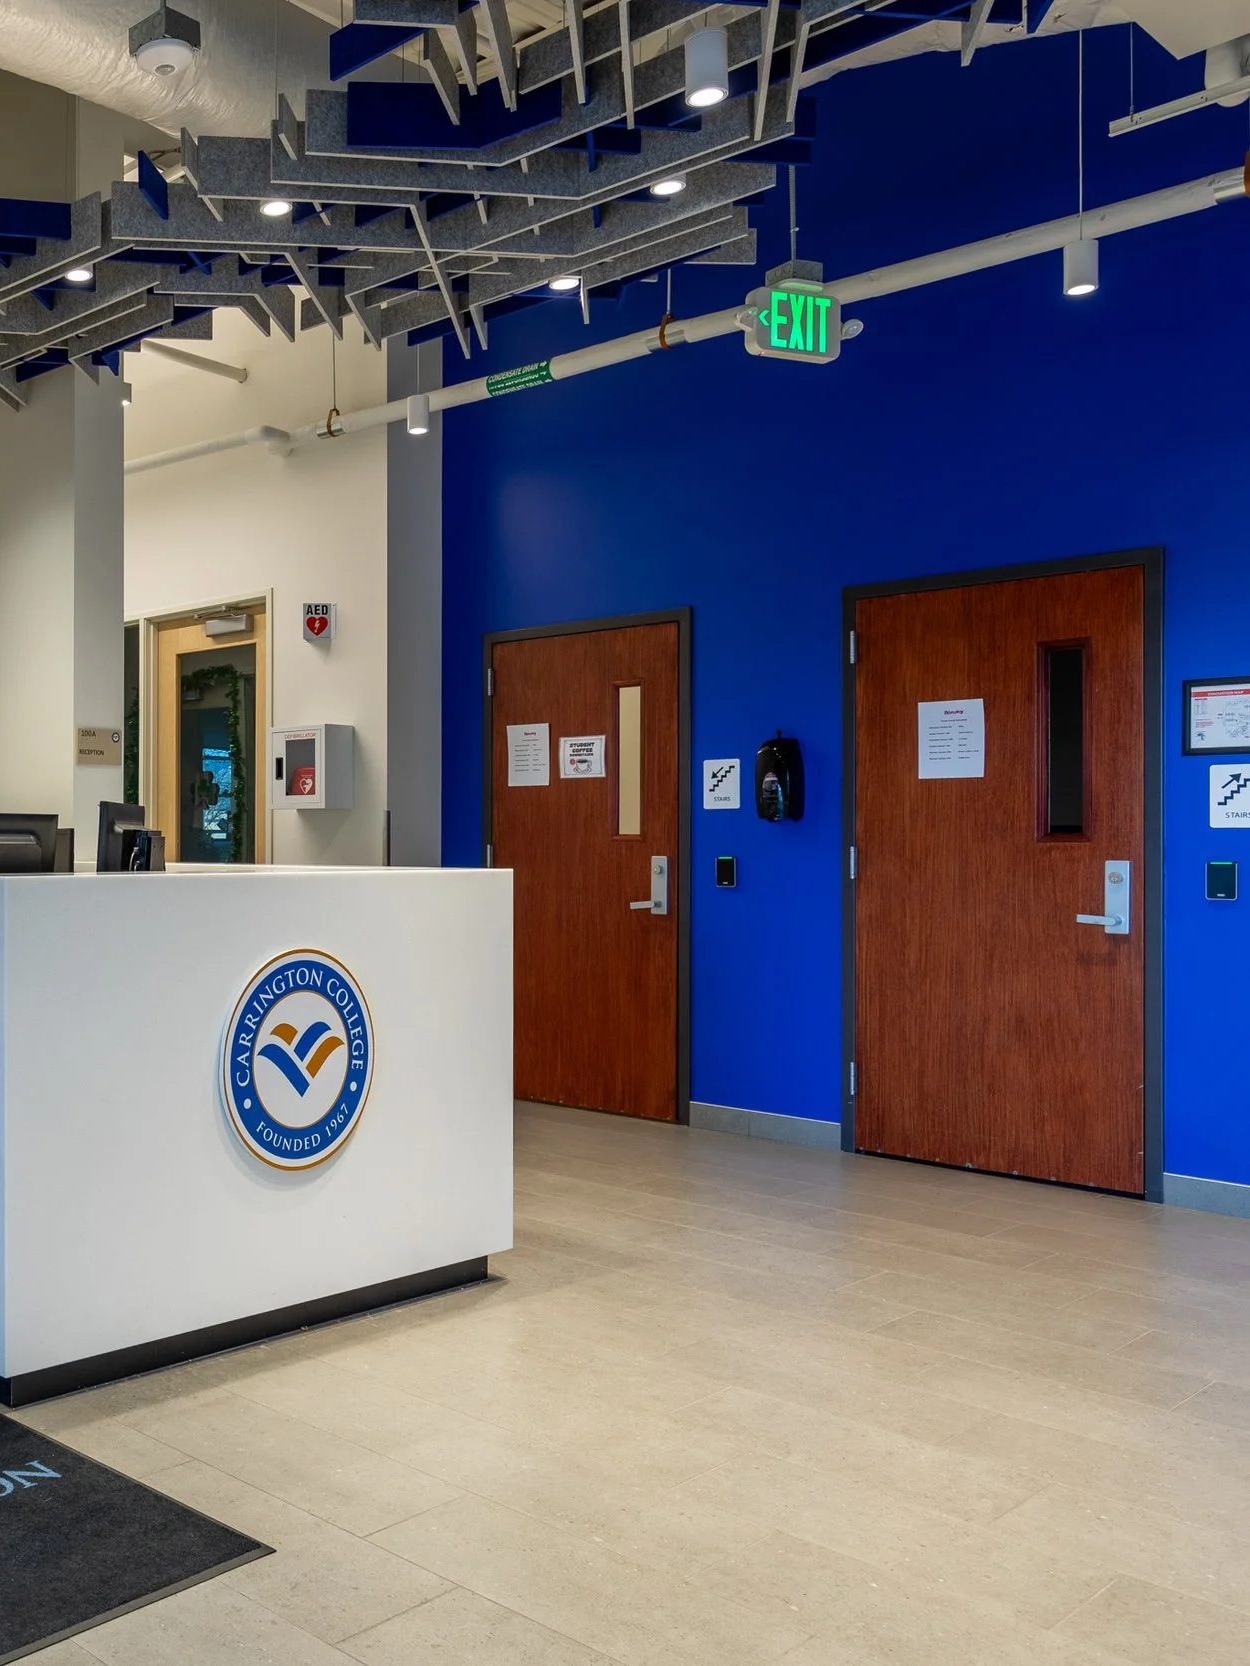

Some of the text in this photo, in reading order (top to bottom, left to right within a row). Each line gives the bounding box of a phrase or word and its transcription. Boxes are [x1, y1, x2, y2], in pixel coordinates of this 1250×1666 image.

[770, 291, 831, 354] EXIT
[306, 604, 329, 616] AED
[81, 729, 97, 738] 100A
[79, 748, 105, 756] RECEPTION
[236, 967, 364, 1088] CARRINGTON COLLEGE
[256, 1103, 350, 1152] FOUNDED 1967
